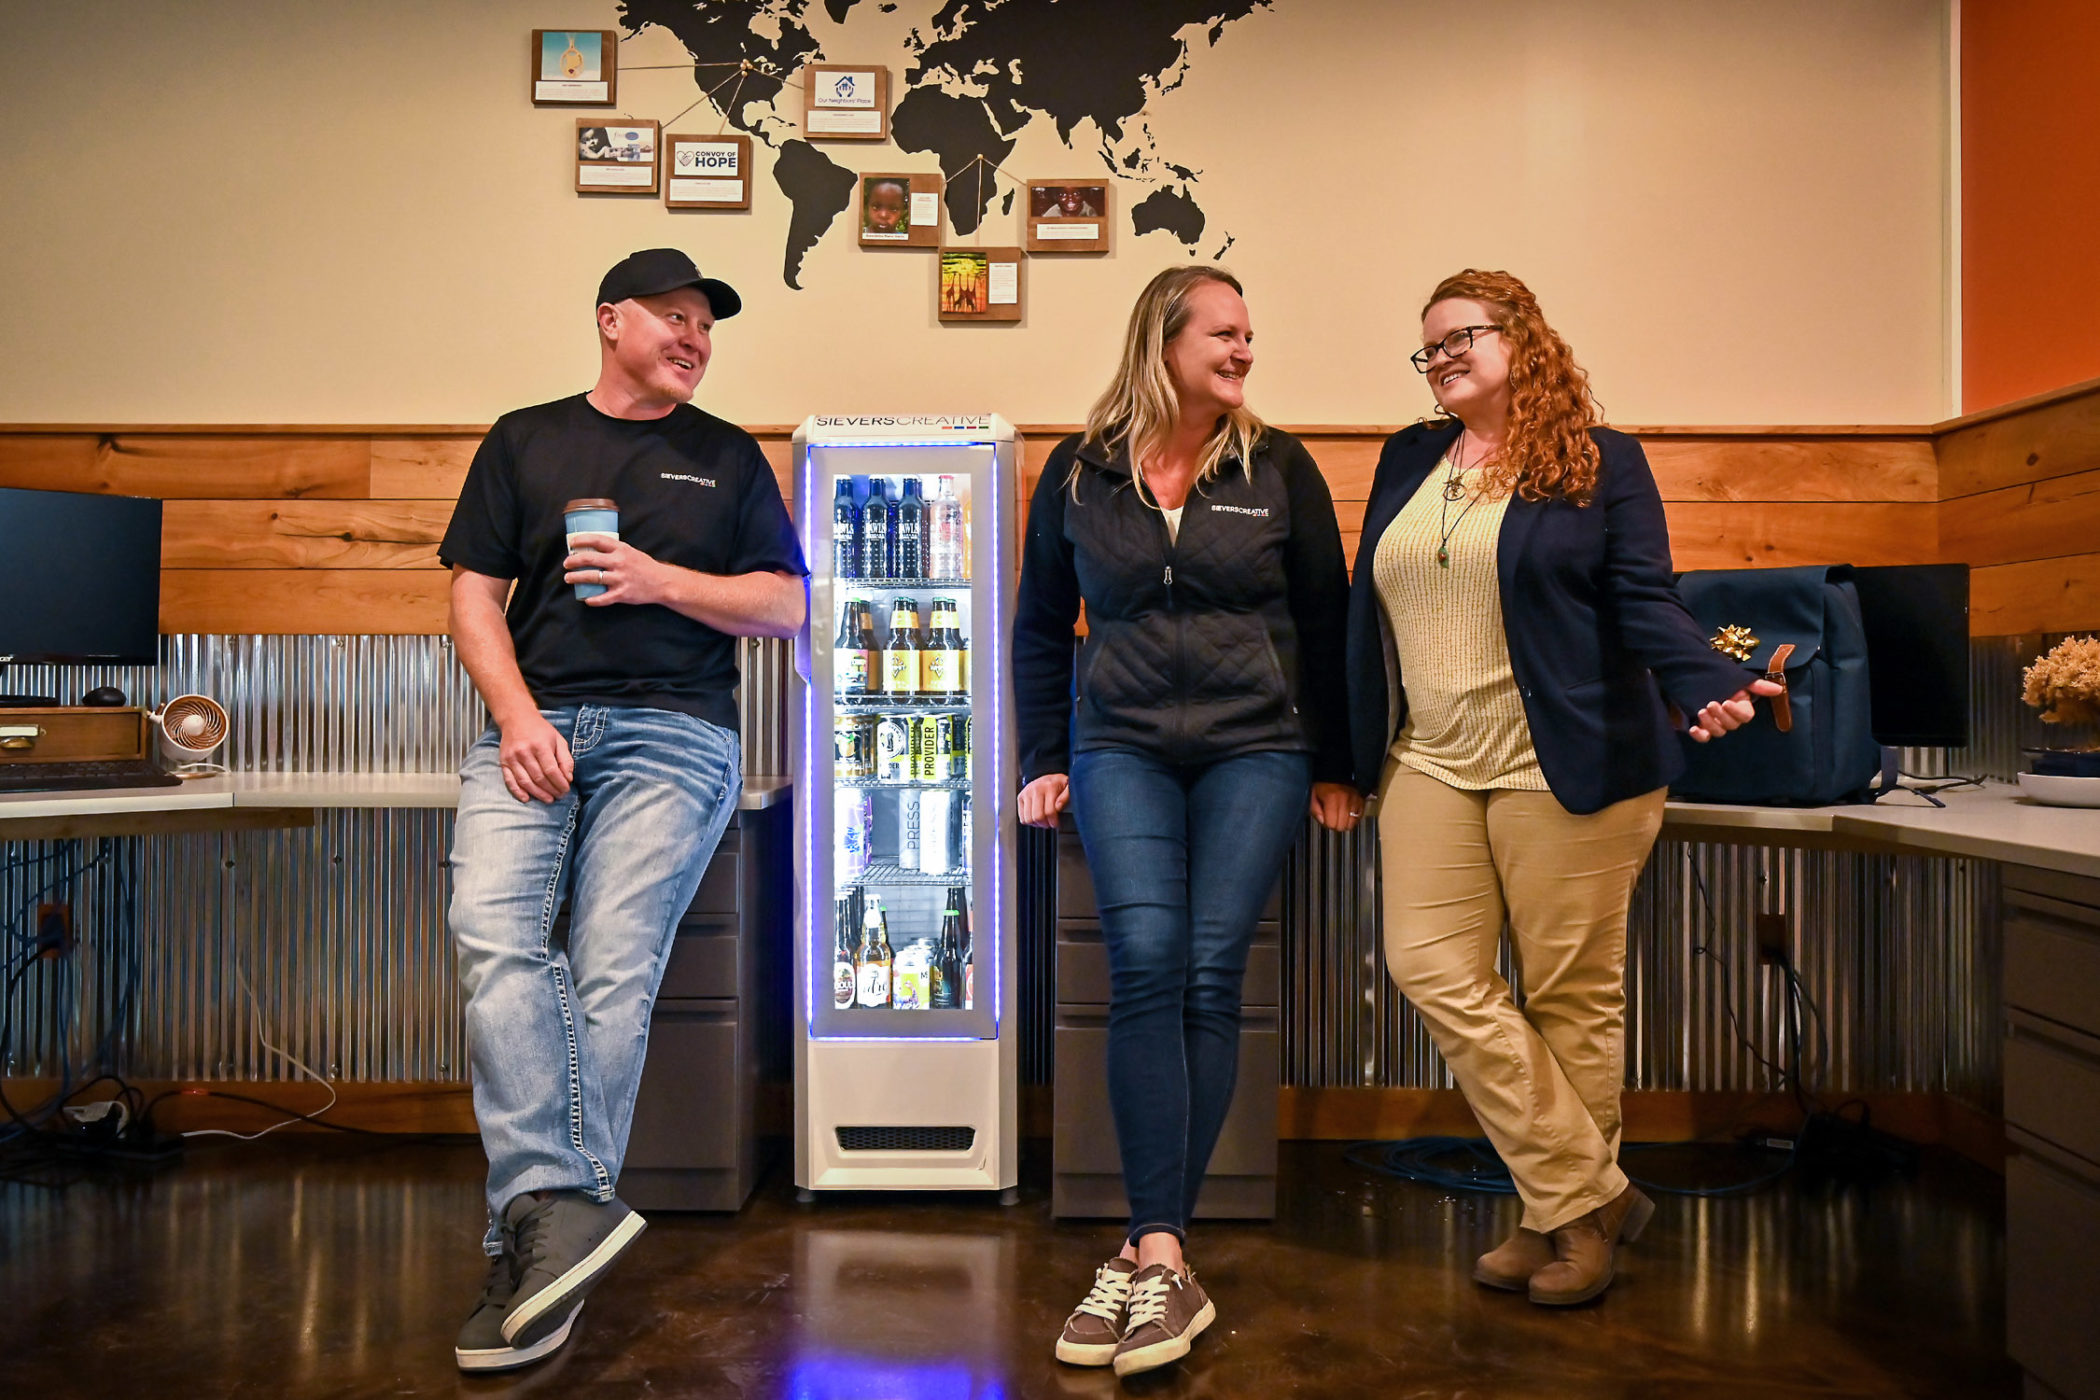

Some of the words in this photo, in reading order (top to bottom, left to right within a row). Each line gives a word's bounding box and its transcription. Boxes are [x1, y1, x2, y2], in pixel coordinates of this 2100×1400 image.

[695, 157, 736, 168] HOPE
[816, 416, 990, 427] SIEVERSCREATIVE
[660, 473, 716, 486] SIEVERSCREATIVE
[1211, 504, 1269, 515] SIEVERSCREATIVE
[924, 726, 936, 776] PROVIDER
[907, 801, 921, 850] PRESS
